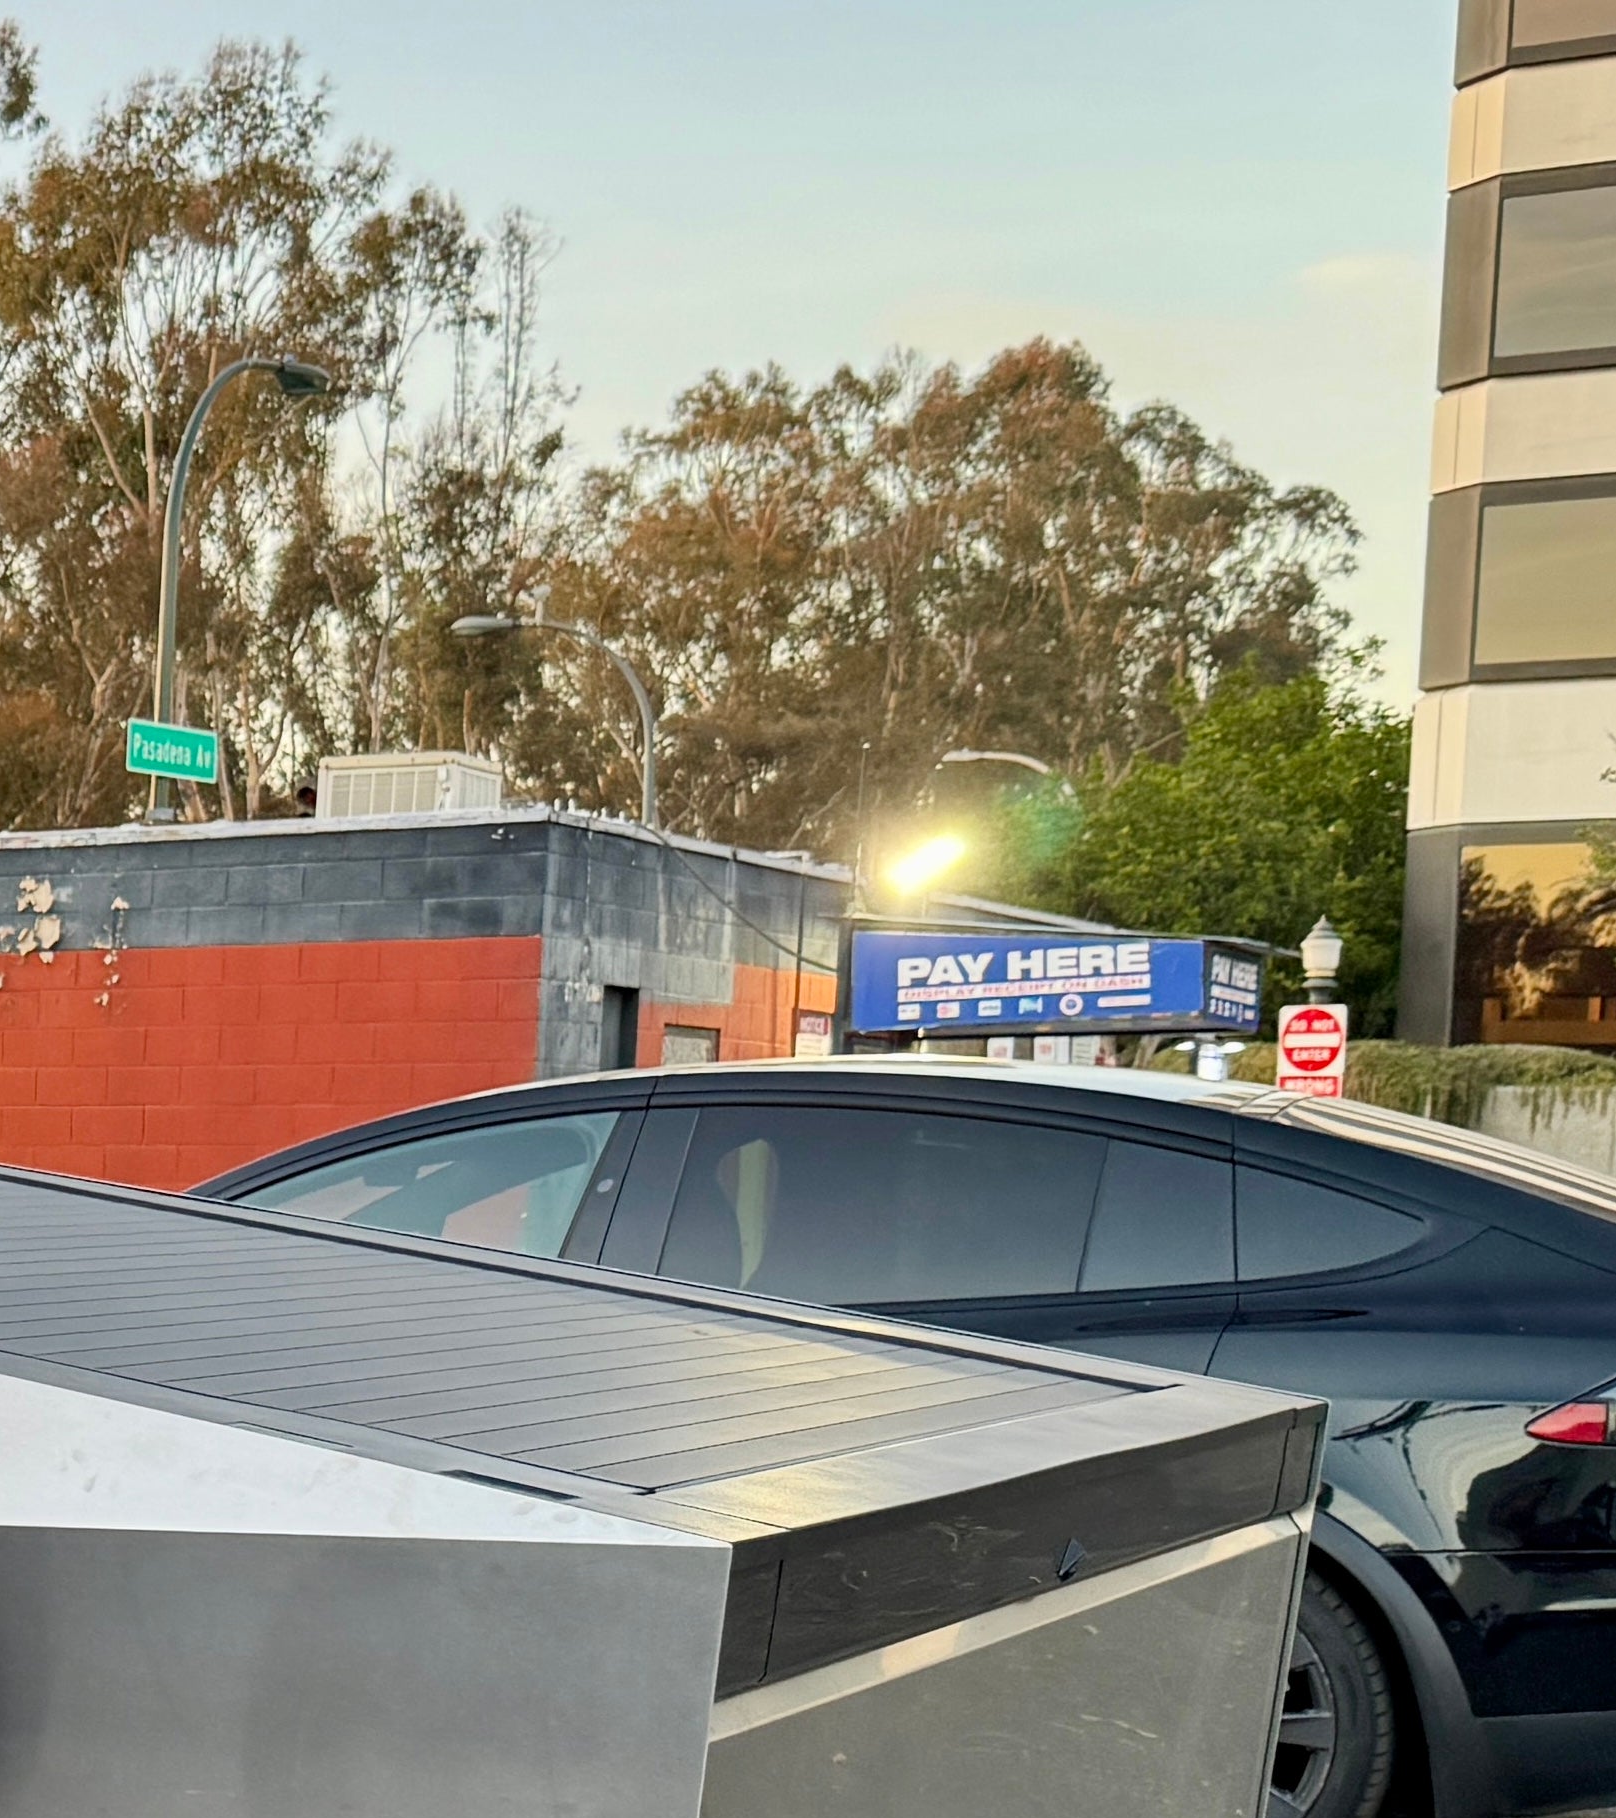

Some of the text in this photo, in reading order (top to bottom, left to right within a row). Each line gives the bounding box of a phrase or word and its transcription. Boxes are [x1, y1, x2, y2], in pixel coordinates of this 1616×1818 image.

[133, 732, 211, 768] Pasadena Av
[897, 942, 1150, 987] PAY HERE
[904, 977, 1143, 999] DISPLAY RECEIPT ON DASH
[1292, 1048, 1330, 1061] ENTER
